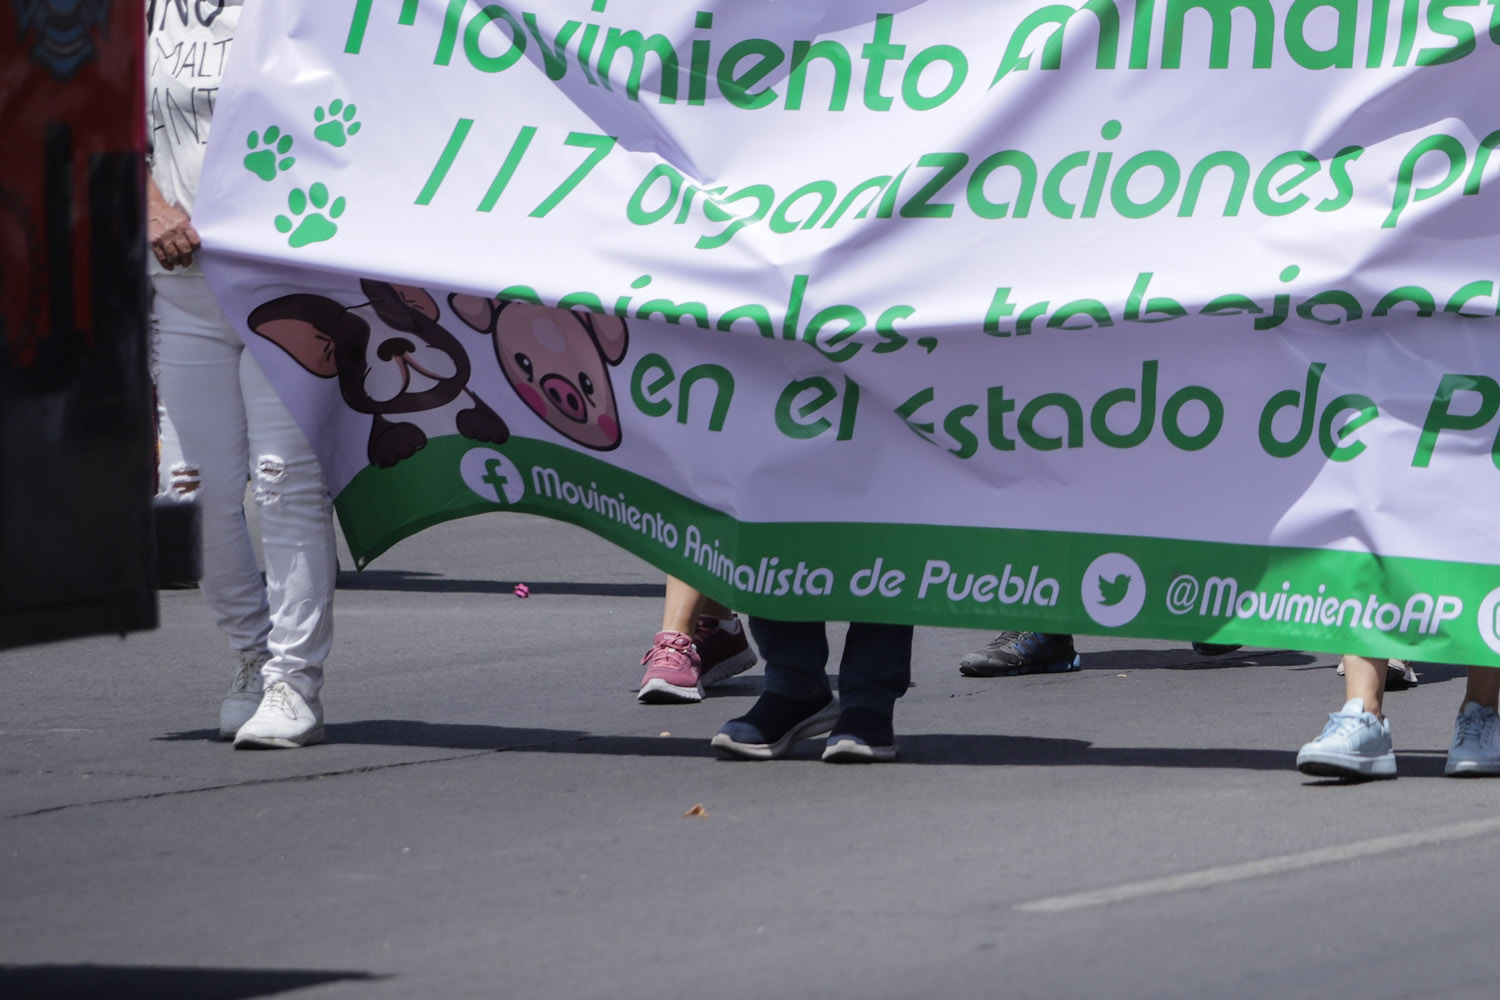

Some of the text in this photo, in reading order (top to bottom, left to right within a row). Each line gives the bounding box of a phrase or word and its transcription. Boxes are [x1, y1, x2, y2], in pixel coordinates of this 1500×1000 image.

[414, 118, 618, 219] 117
[626, 119, 1365, 250] organizaciones
[630, 353, 735, 432] en
[774, 374, 861, 441] el
[1258, 361, 1379, 463] de
[531, 465, 1060, 607] Movimiento Animalista de Puebla
[1166, 574, 1463, 635] @MovimientoAP
